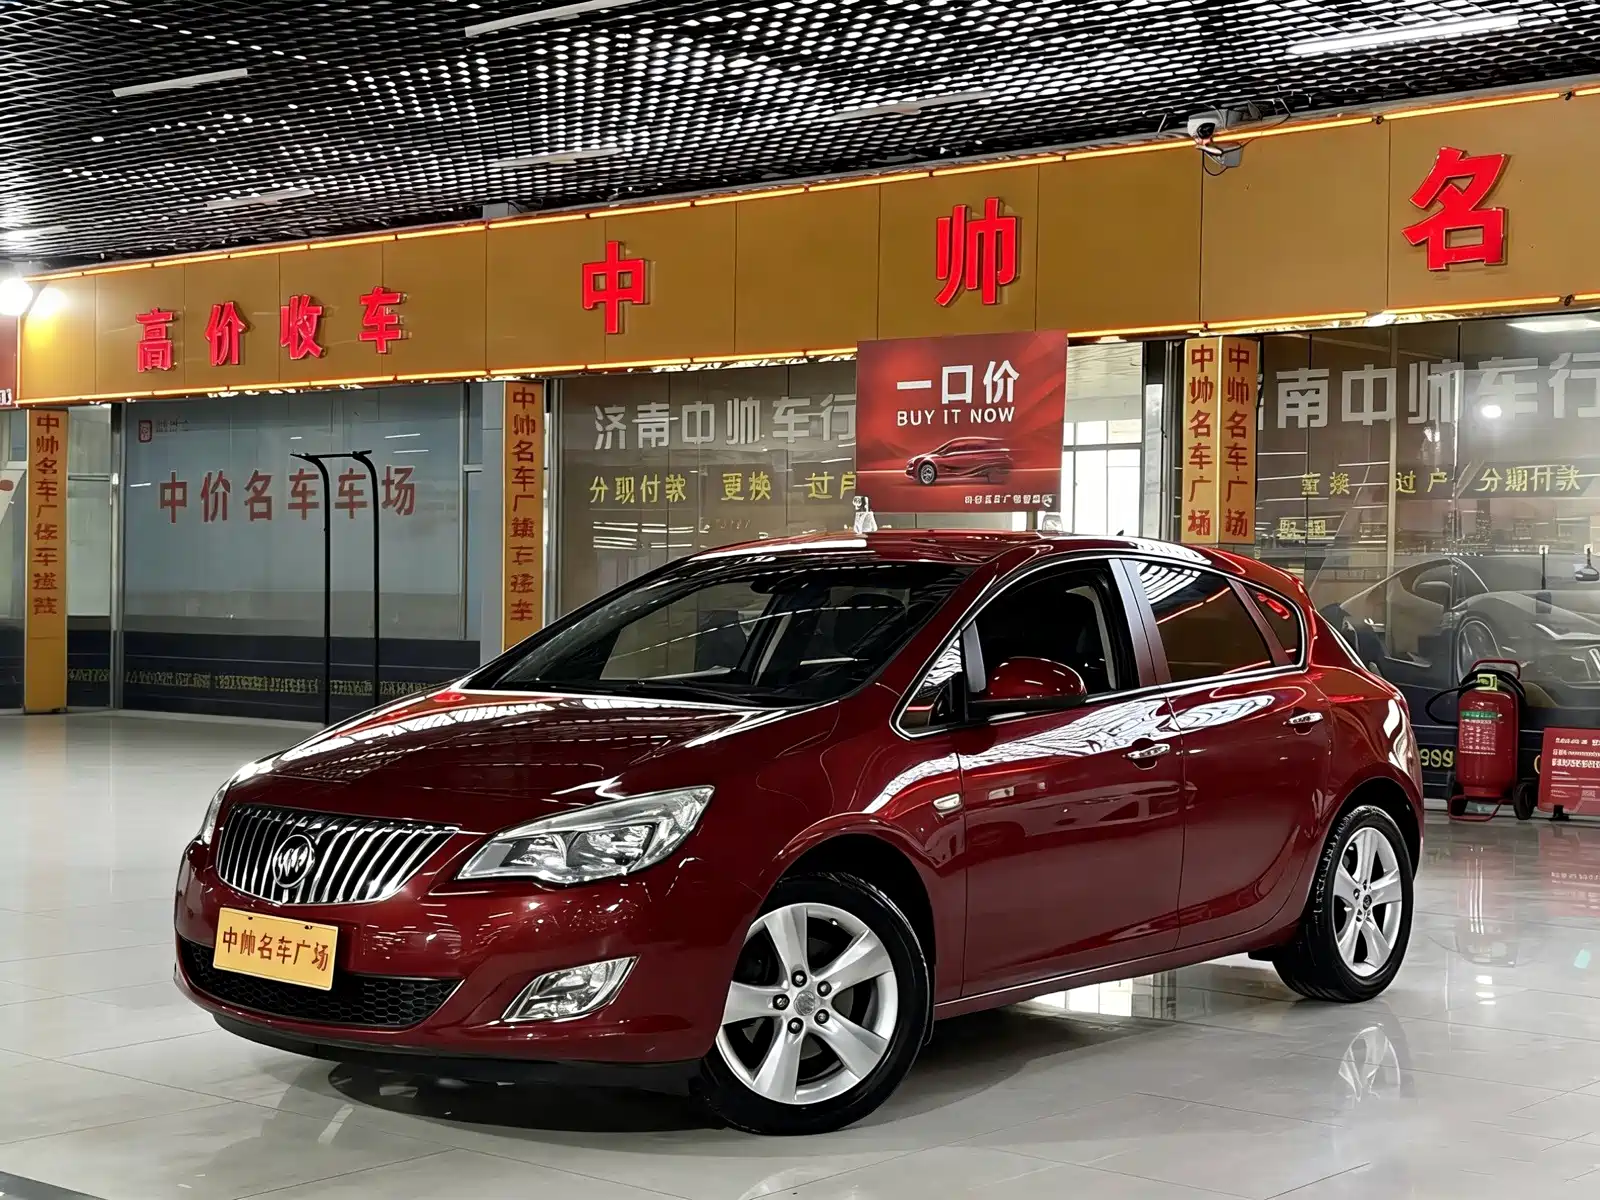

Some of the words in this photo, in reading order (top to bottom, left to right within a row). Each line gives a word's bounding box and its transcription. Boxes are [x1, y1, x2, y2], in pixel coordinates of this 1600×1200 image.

[135, 286, 406, 373] 高价收车
[897, 360, 1020, 404] 一口价
[897, 409, 935, 426] BUY
[944, 409, 961, 425] IT
[970, 407, 1016, 424] NOW
[1188, 344, 1215, 536] 中帅名车广场
[222, 926, 329, 972] 中帅名车广场
